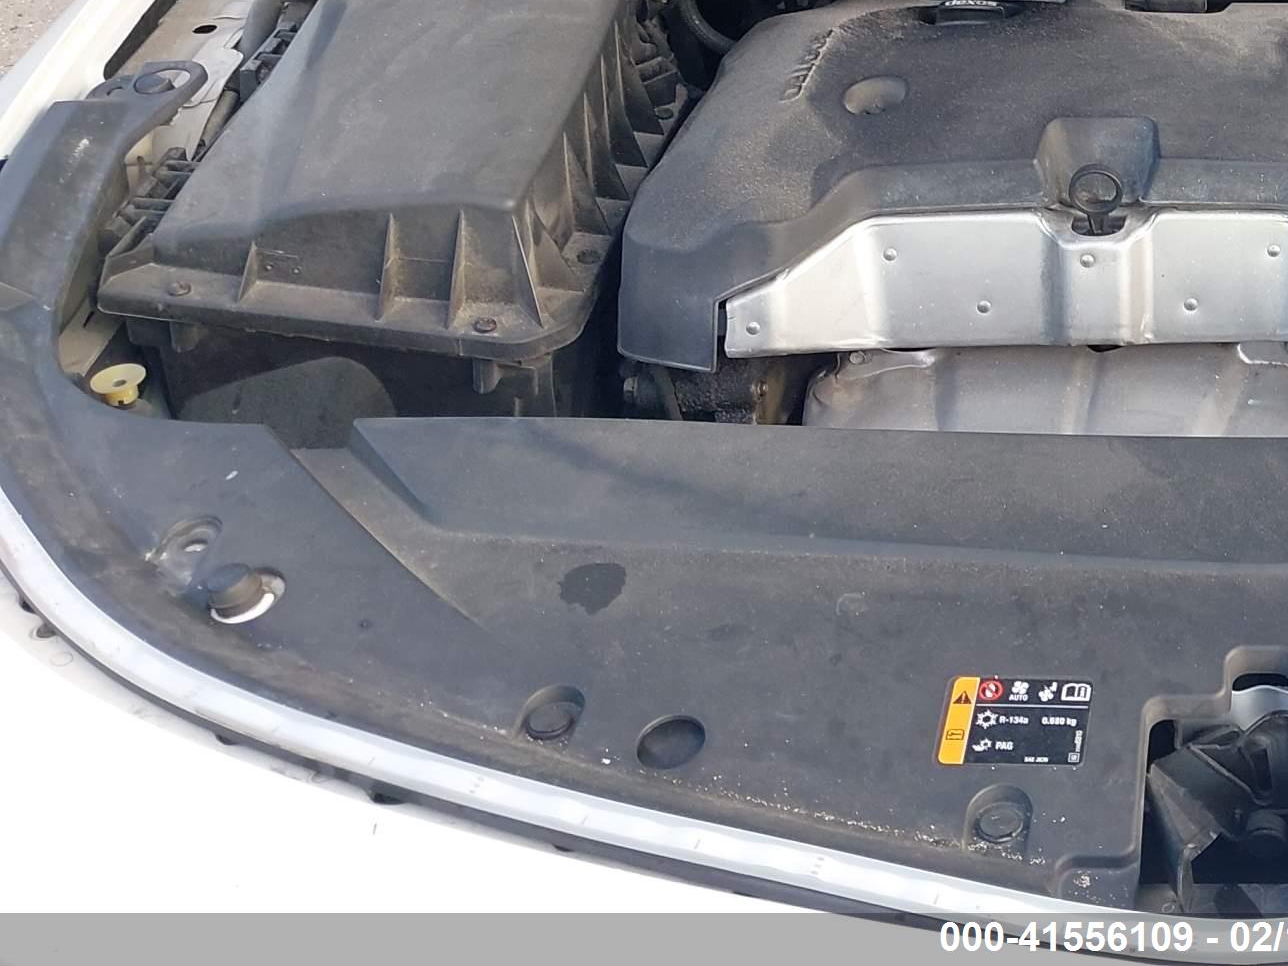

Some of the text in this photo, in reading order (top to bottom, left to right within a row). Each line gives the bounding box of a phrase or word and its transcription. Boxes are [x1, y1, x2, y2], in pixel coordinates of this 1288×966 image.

[944, 0, 998, 7] dexos
[1009, 694, 1029, 702] AUTO
[999, 715, 1029, 724] R-134a
[1066, 717, 1077, 727] kg
[995, 741, 1014, 751] PAG
